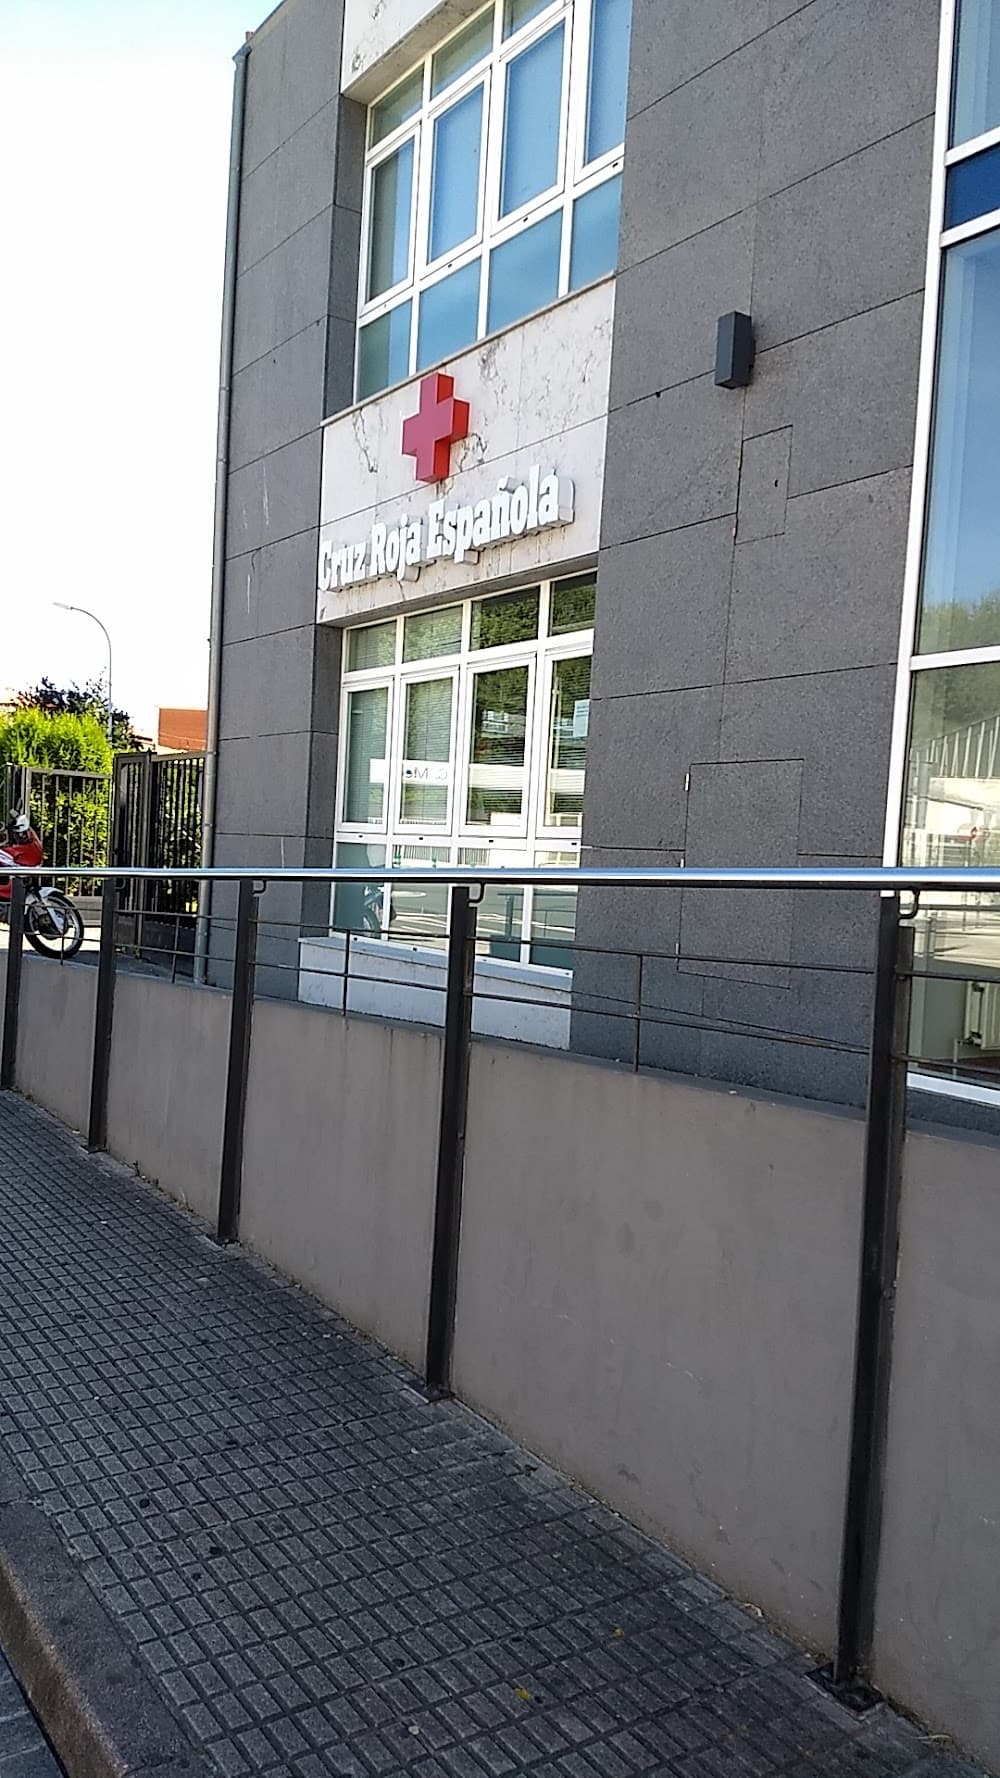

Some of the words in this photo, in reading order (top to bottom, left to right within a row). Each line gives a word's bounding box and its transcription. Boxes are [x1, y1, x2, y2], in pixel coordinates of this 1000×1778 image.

[319, 540, 367, 591] Cruz
[369, 513, 421, 581] Roja
[426, 464, 560, 563] Española
